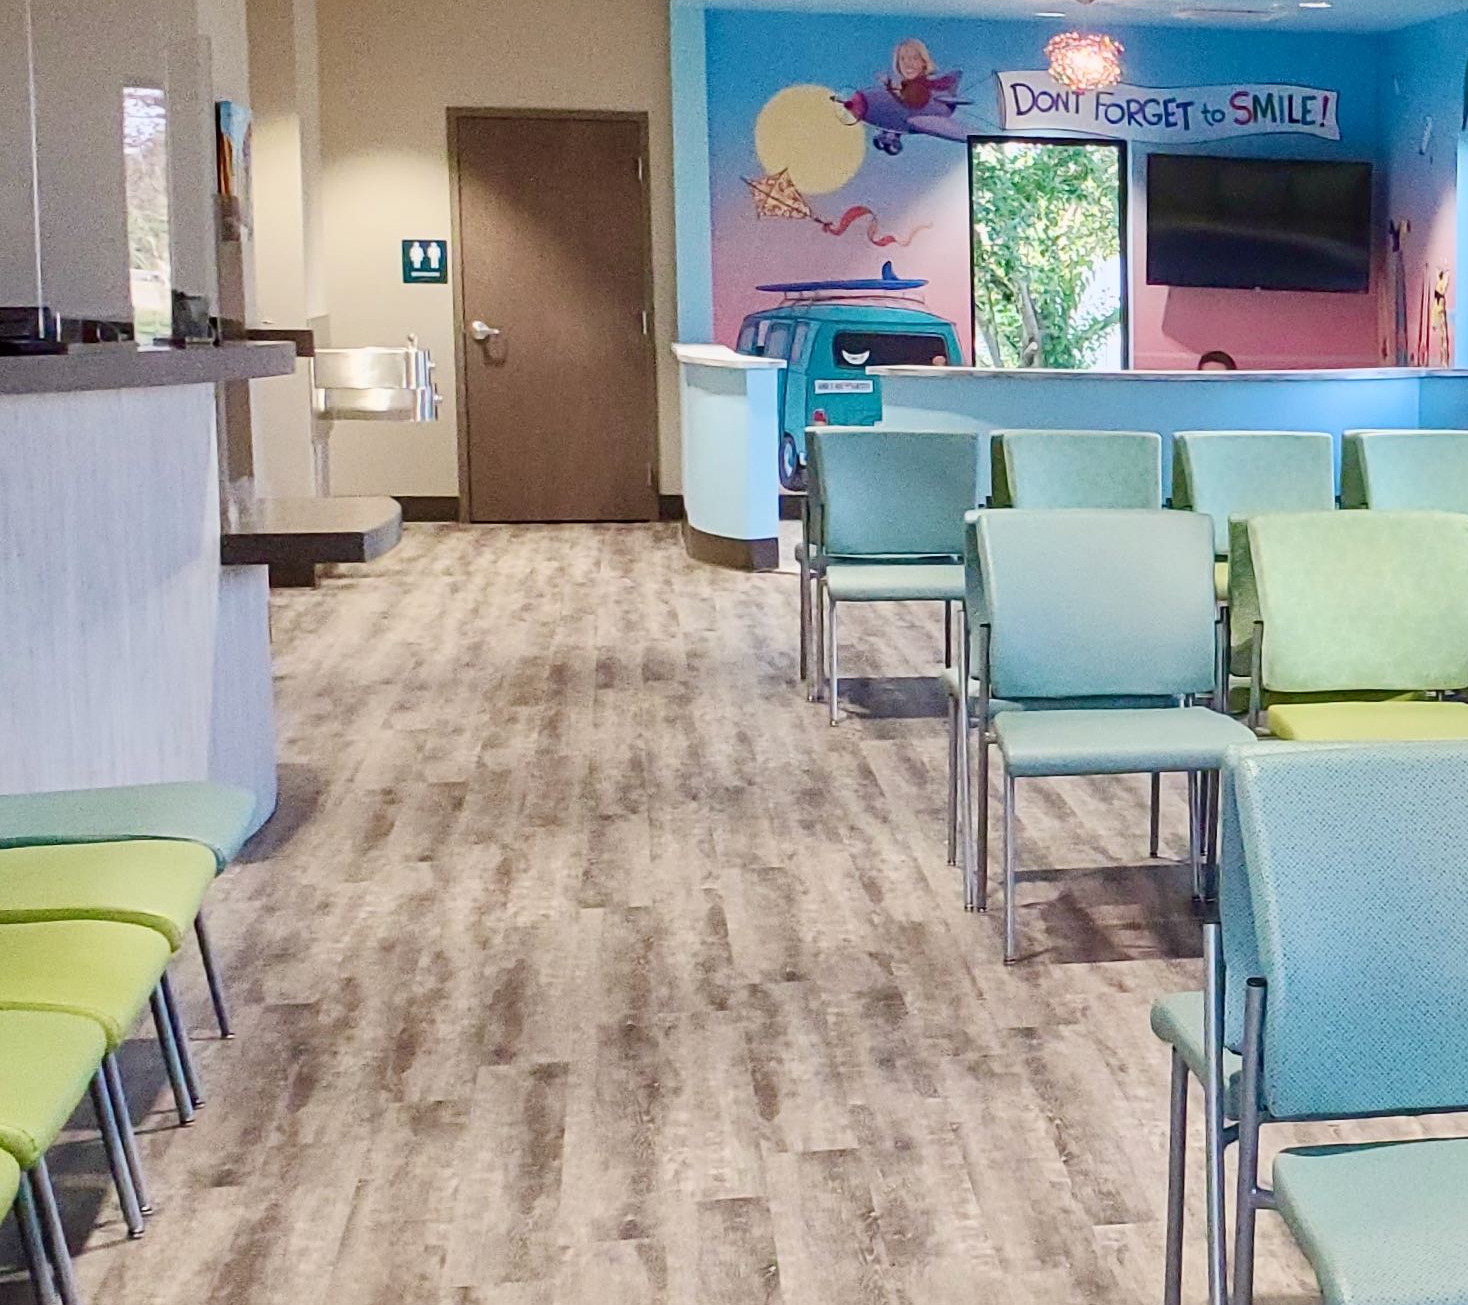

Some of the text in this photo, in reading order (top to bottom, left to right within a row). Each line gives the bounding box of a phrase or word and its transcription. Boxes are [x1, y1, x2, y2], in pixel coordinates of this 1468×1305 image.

[1095, 92, 1194, 131] FORGET
[1201, 103, 1226, 127] to
[1229, 91, 1330, 127] SMILE!
